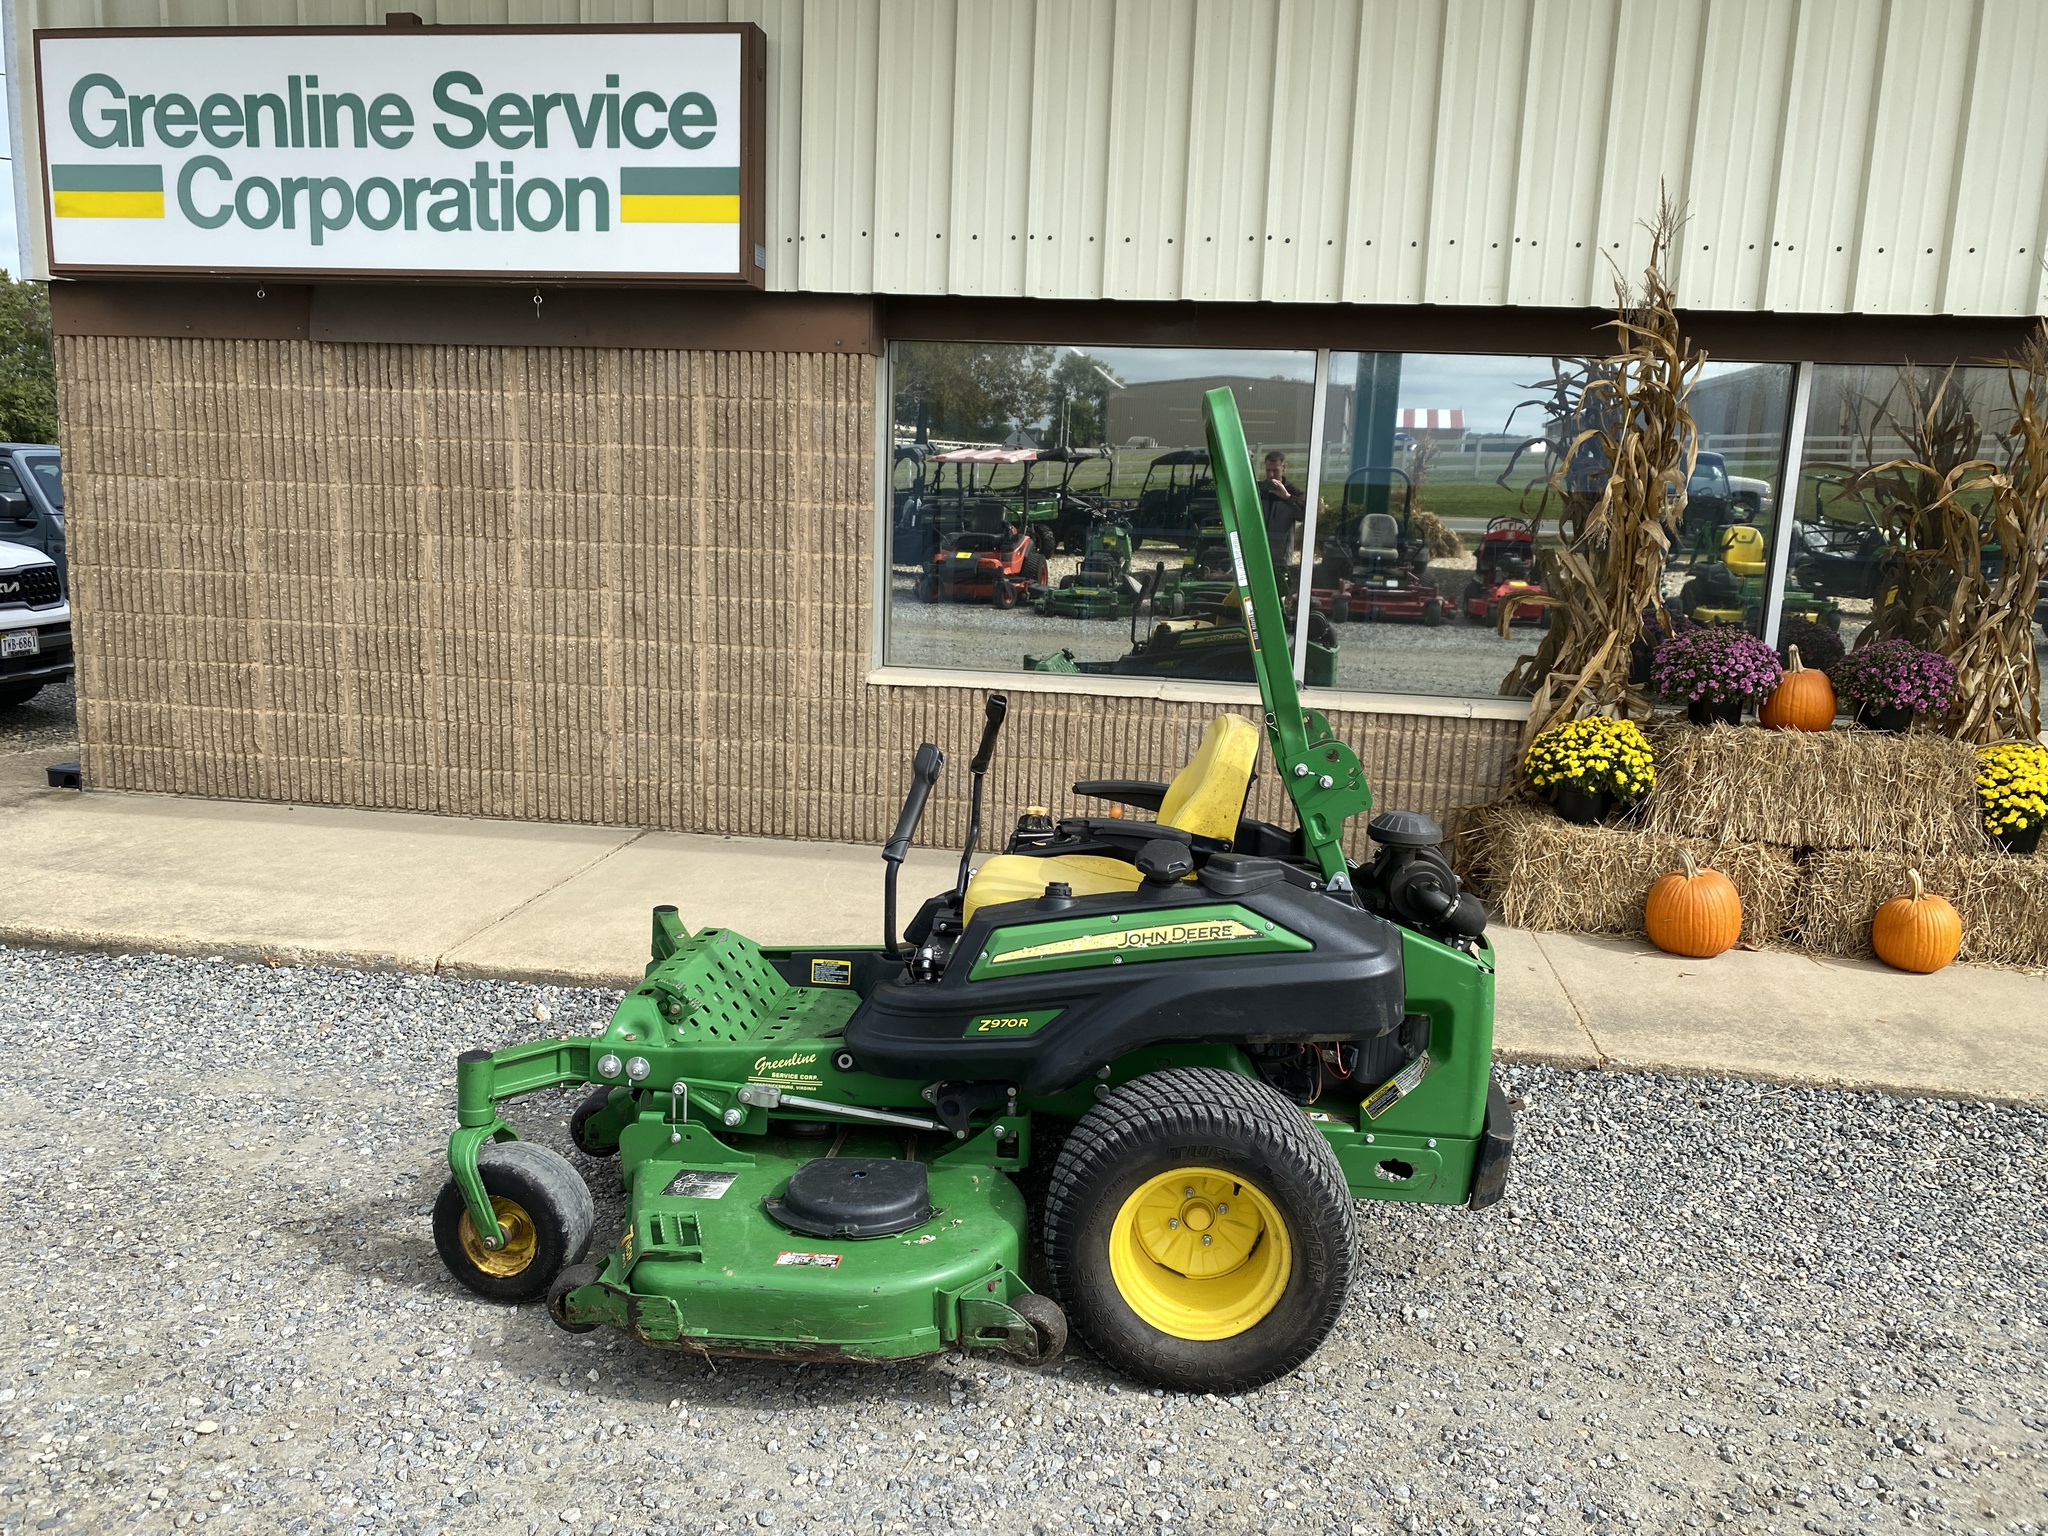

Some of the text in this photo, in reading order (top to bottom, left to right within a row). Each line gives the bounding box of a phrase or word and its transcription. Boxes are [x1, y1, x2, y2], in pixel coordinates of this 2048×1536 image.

[68, 70, 718, 150] Greenline Service
[177, 155, 610, 246] Corporation
[1118, 925, 1233, 946] JOHN DEERE
[978, 1018, 1028, 1031] Z970R
[754, 1053, 817, 1076] Greenline
